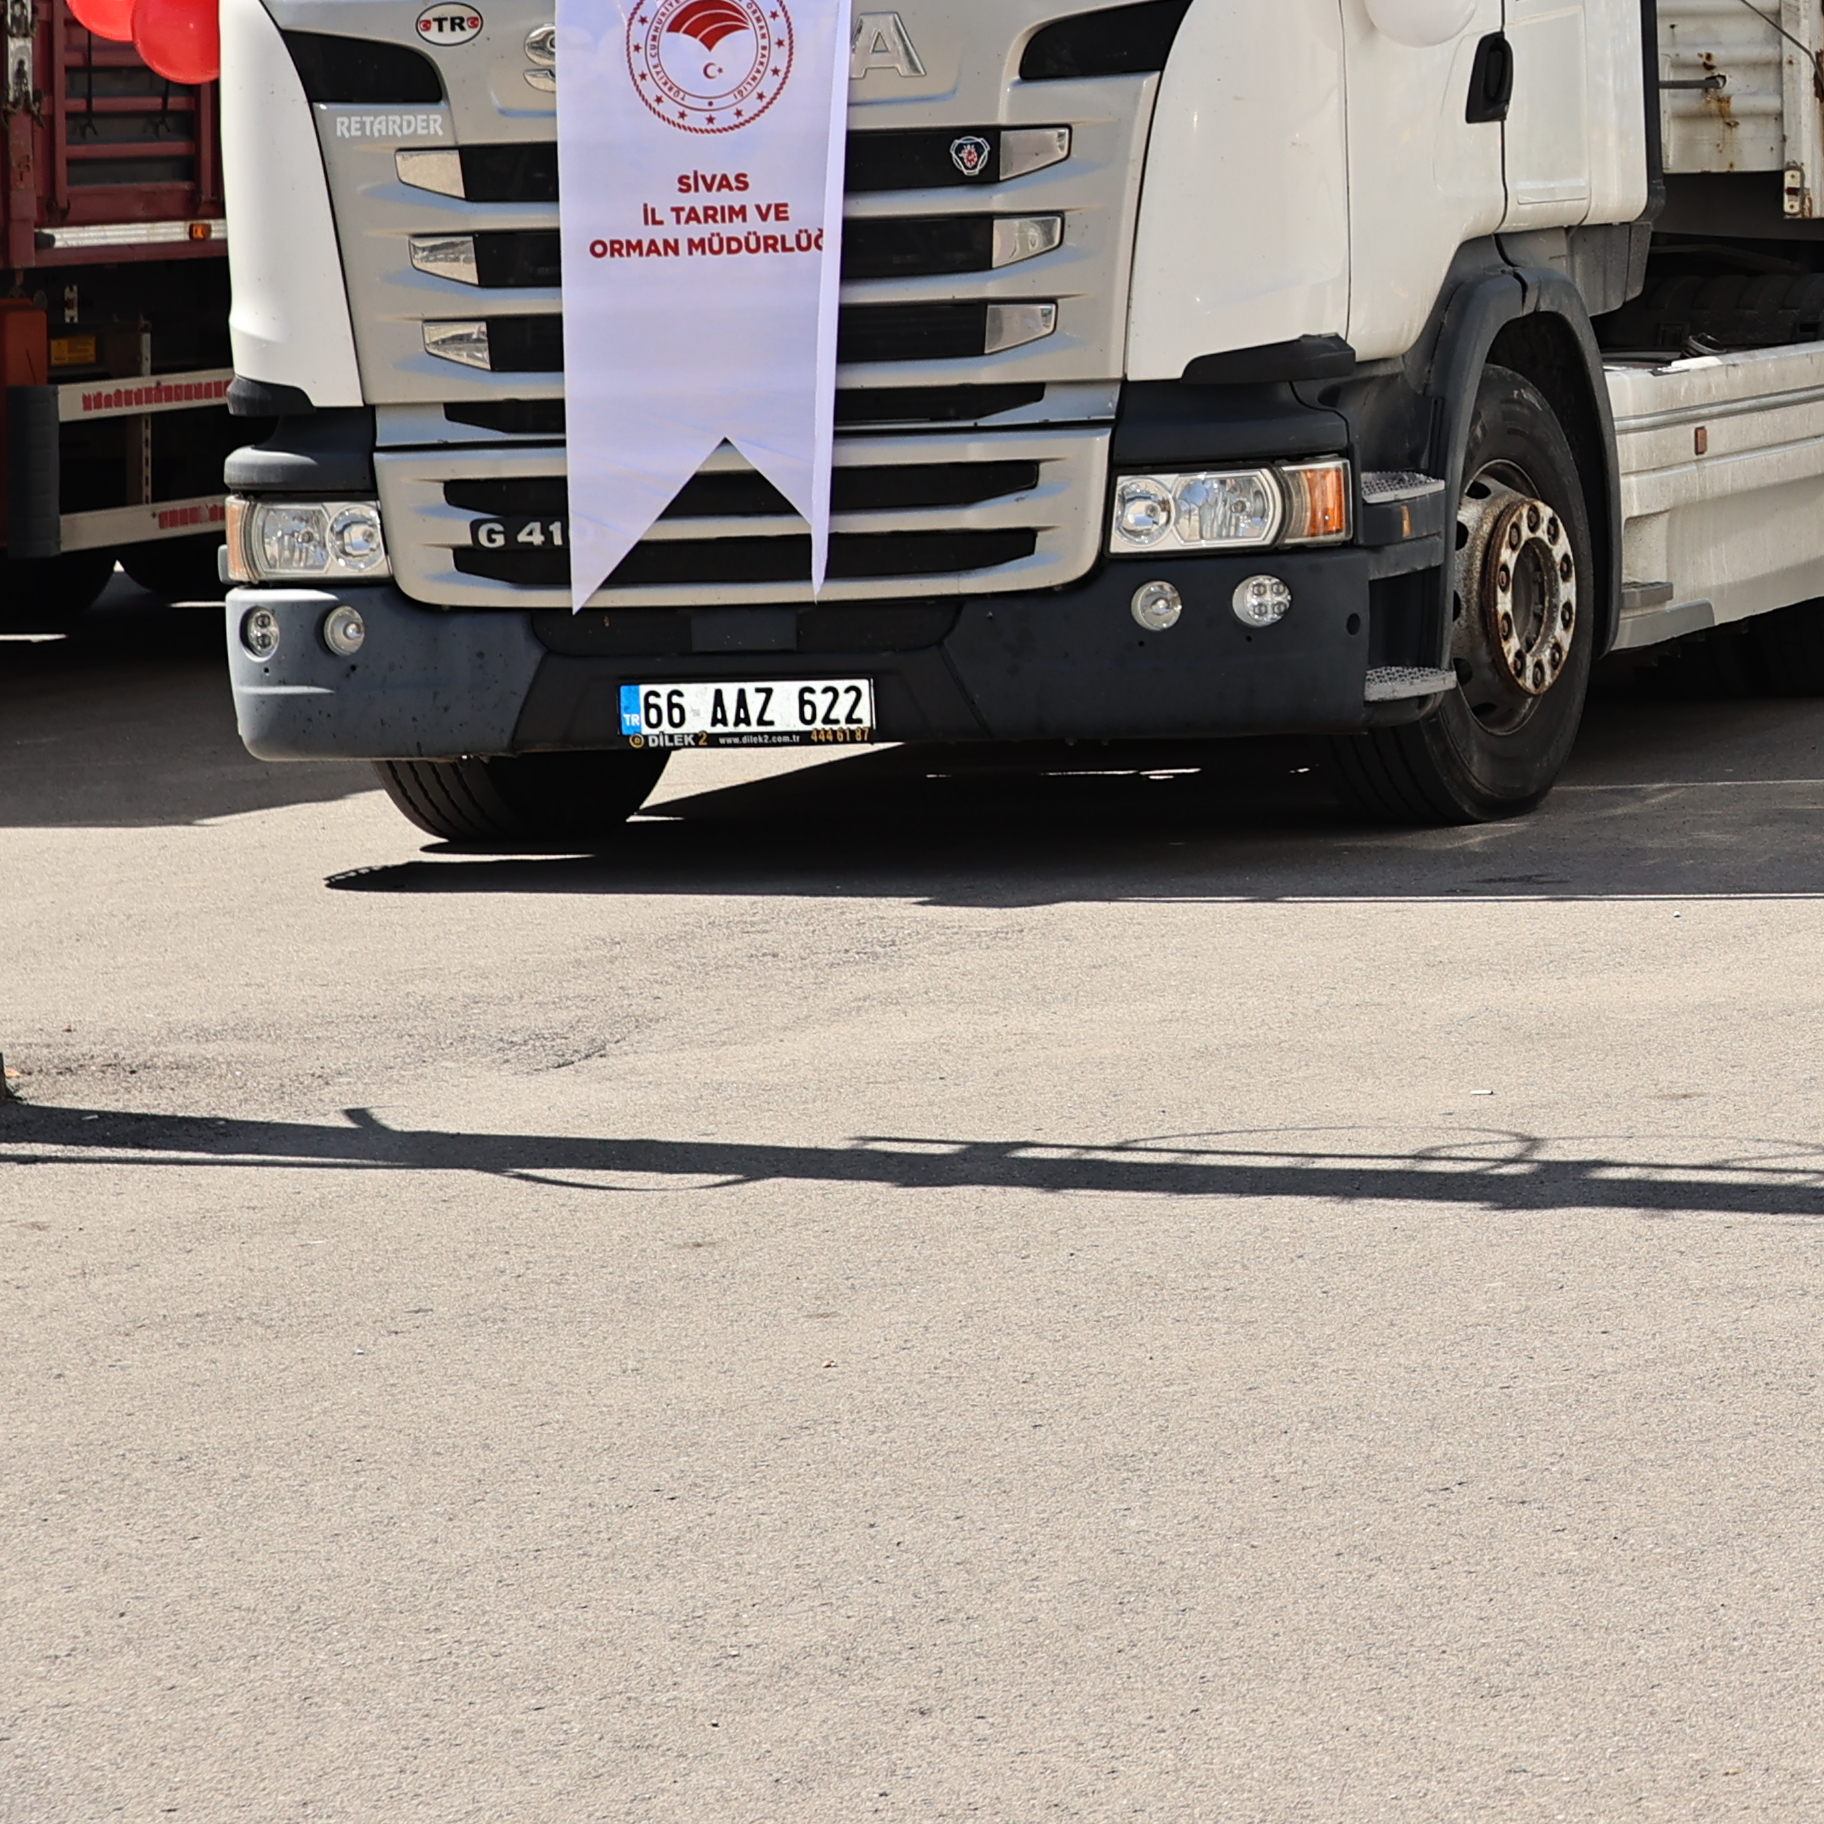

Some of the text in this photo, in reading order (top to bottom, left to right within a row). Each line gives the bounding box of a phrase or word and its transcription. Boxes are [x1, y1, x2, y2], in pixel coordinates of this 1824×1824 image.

[432, 16, 467, 33] TR
[746, 2, 767, 39] ORMAN
[651, 62, 686, 102] TÜRKİYE
[734, 44, 768, 100] BAKANLIĞI
[336, 114, 443, 139] RETARDER
[677, 170, 750, 194] SİVAS
[643, 202, 789, 226] İL TARIM VE
[589, 238, 679, 258] ORMAN
[478, 521, 563, 548] G 41
[623, 685, 863, 728] TR 66 AAZ 622
[648, 727, 870, 747] DİLEK 2 www.dilek2.com.tr 444 61 87
